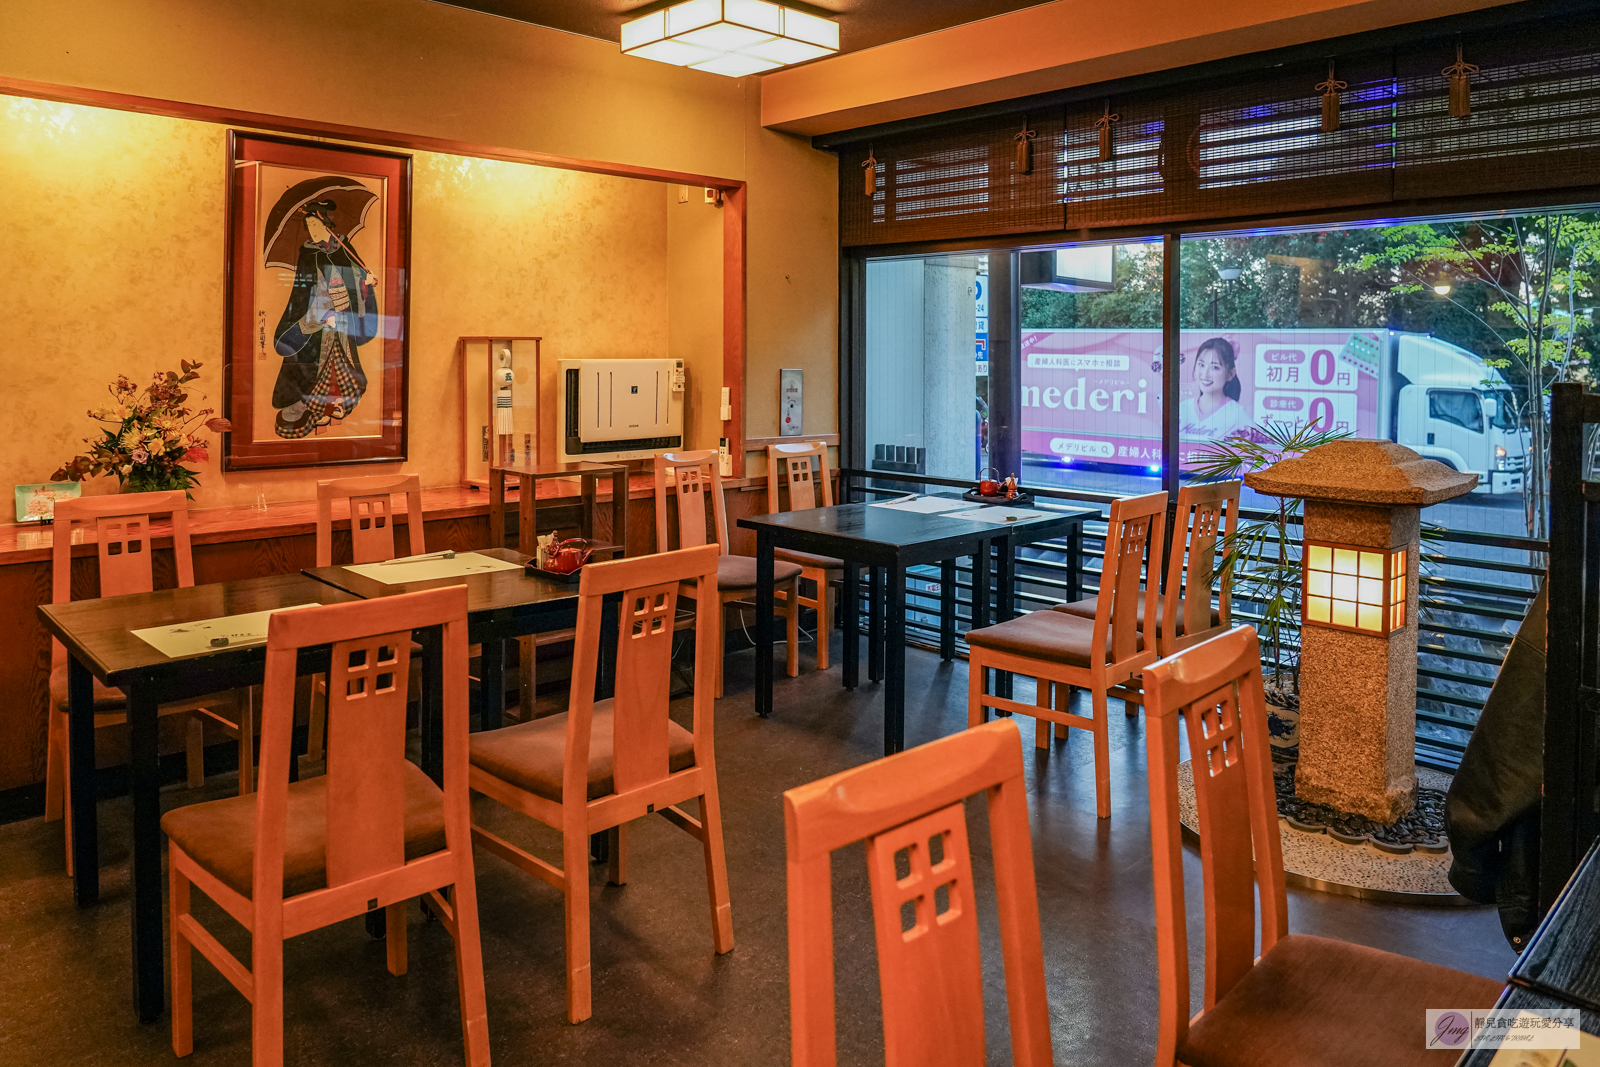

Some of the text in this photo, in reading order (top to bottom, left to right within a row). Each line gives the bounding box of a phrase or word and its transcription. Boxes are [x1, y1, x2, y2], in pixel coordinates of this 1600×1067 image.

[1034, 357, 1121, 368] 産婦人科医にスマホで相談
[1269, 399, 1297, 409] 診療代
